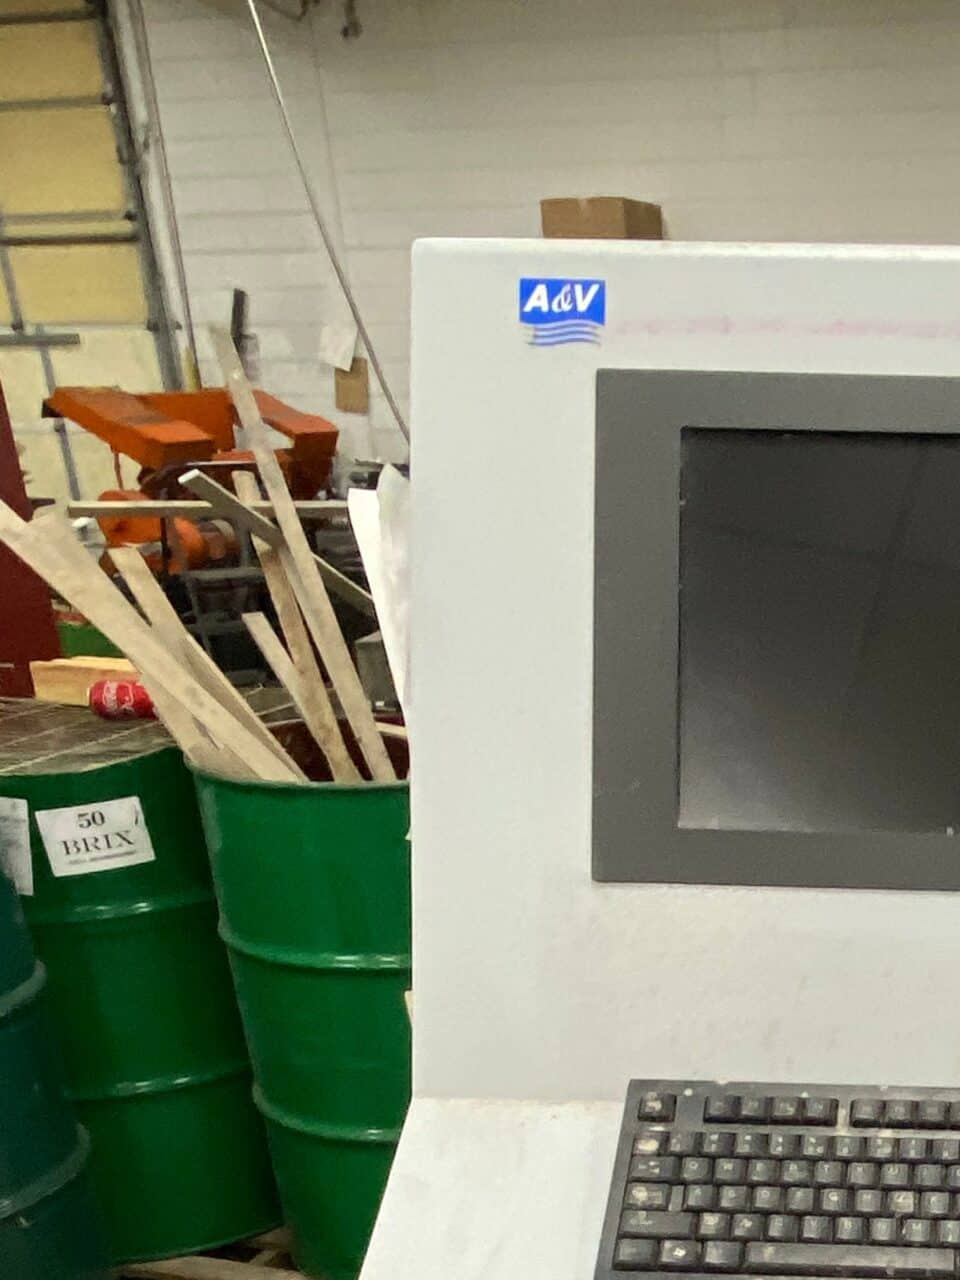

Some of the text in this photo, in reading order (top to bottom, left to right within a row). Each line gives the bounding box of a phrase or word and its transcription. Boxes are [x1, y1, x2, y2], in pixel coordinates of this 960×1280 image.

[523, 283, 600, 313] A&V
[77, 811, 105, 829] 50
[62, 830, 134, 855] BRIX
